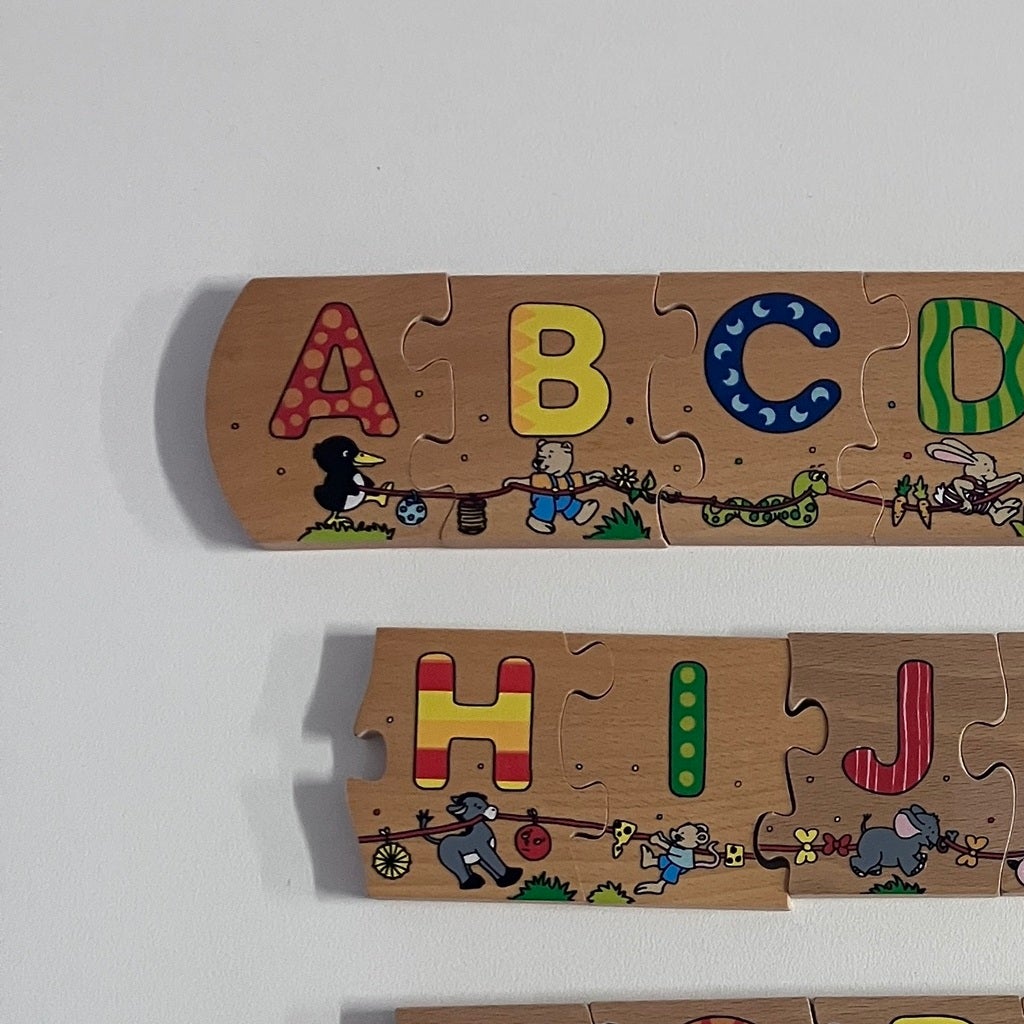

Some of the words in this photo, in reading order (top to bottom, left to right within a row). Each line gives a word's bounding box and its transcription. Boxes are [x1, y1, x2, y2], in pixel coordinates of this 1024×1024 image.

[269, 302, 399, 439] A
[508, 303, 611, 437] B
[704, 292, 842, 434] C
[412, 651, 535, 792] H
[669, 660, 707, 797] I
[841, 658, 935, 795] J
